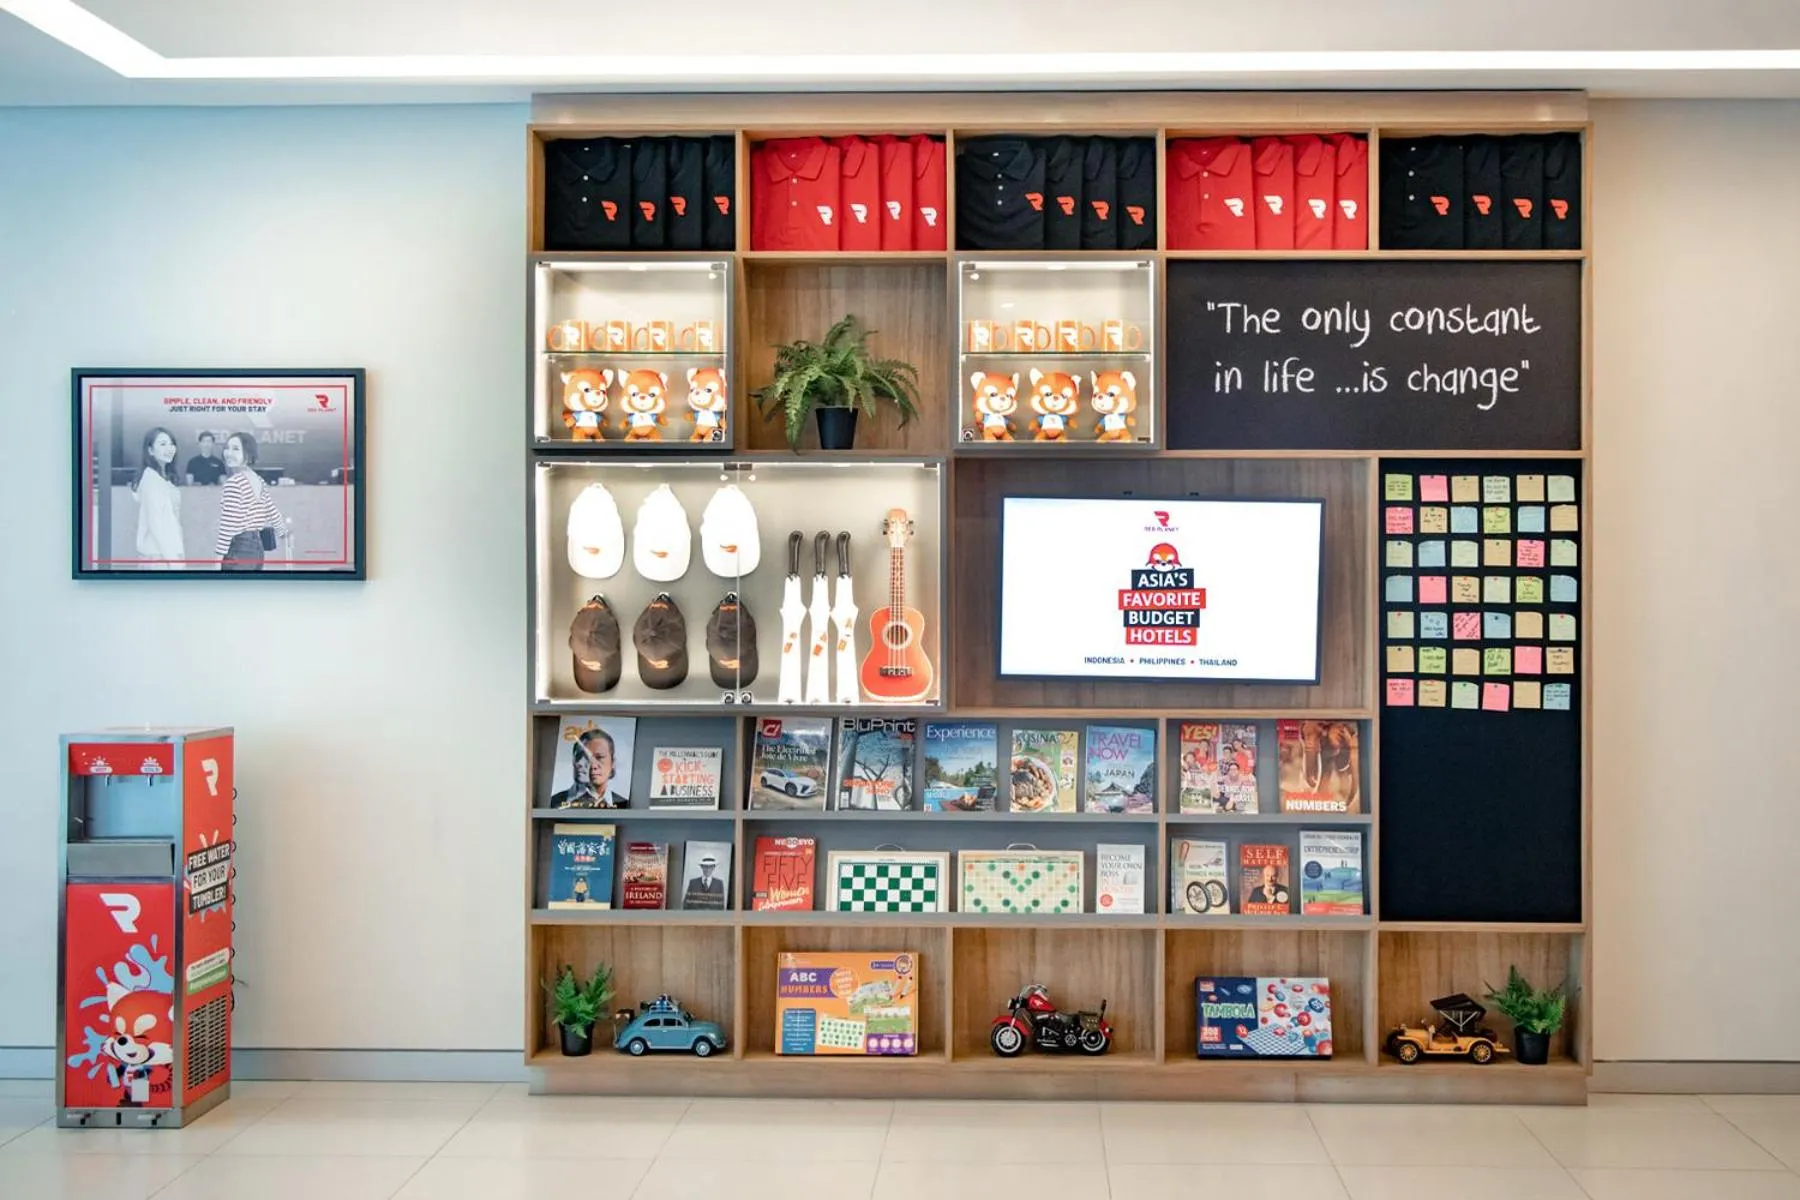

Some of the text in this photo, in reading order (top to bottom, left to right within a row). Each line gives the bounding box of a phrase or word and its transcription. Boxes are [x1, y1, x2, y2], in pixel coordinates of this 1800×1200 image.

[1206, 301, 1541, 349] "The only constant
[1214, 356, 1530, 411] in life ...is change"
[221, 397, 237, 405] AND
[238, 397, 272, 405] FRIENDLY
[169, 405, 267, 413] JUST RIGHT FOR YOUR STAY
[1138, 573, 1188, 588] ASIA'S
[1123, 592, 1201, 607] FAVORITE
[1128, 610, 1195, 625] BUDGET
[1130, 629, 1192, 644] HOTELS
[1084, 656, 1238, 667] INDONESIA PHILIPPINES THAILAND
[842, 717, 916, 733] BluPrint
[1182, 724, 1218, 741] YES!
[926, 724, 996, 742] Experience
[1090, 730, 1142, 749] TRAVEL
[1087, 747, 1129, 763] NOW
[662, 772, 714, 785] STARTING
[1103, 769, 1135, 779] JAPAN
[660, 784, 714, 797] A BUSINESS
[1285, 800, 1347, 812] NUMBERS
[188, 843, 230, 871] FREE WATER
[1245, 848, 1285, 859] SELF
[763, 855, 813, 874] FIFTY
[193, 864, 225, 889] FOR YOUR
[767, 872, 808, 891] FIVE
[625, 891, 662, 900] IRELAND
[789, 972, 818, 983] ABC
[780, 984, 828, 994] NUMBERS
